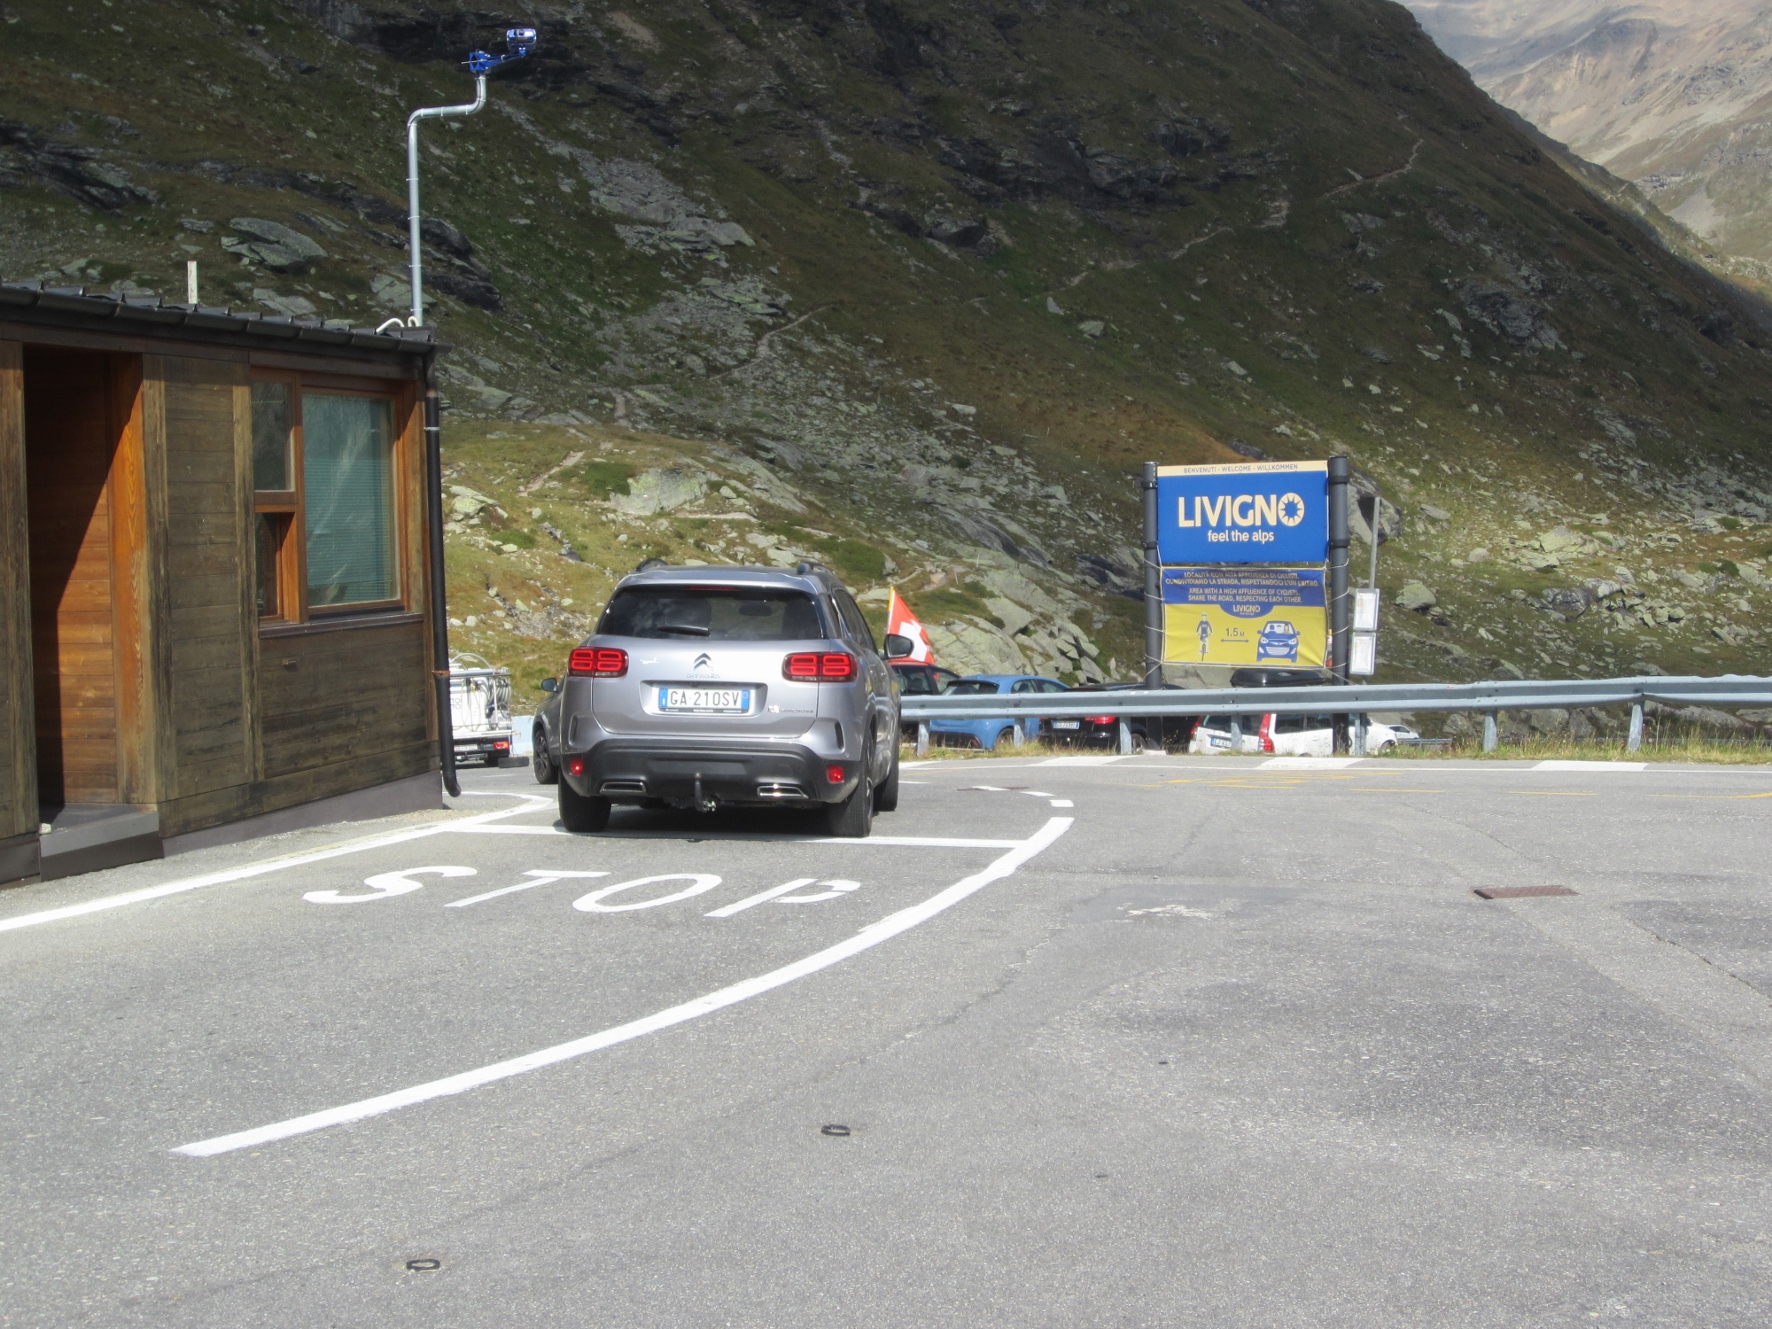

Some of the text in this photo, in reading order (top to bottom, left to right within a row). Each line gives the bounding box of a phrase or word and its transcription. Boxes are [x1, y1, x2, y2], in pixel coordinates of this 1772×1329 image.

[1178, 492, 1305, 527] LIVIGNO
[1208, 530, 1274, 544] feel the alps
[1233, 604, 1260, 612] LIVIGNO
[1226, 628, 1238, 636] 1.5
[670, 690, 687, 706] GA
[303, 865, 861, 917] STOP
